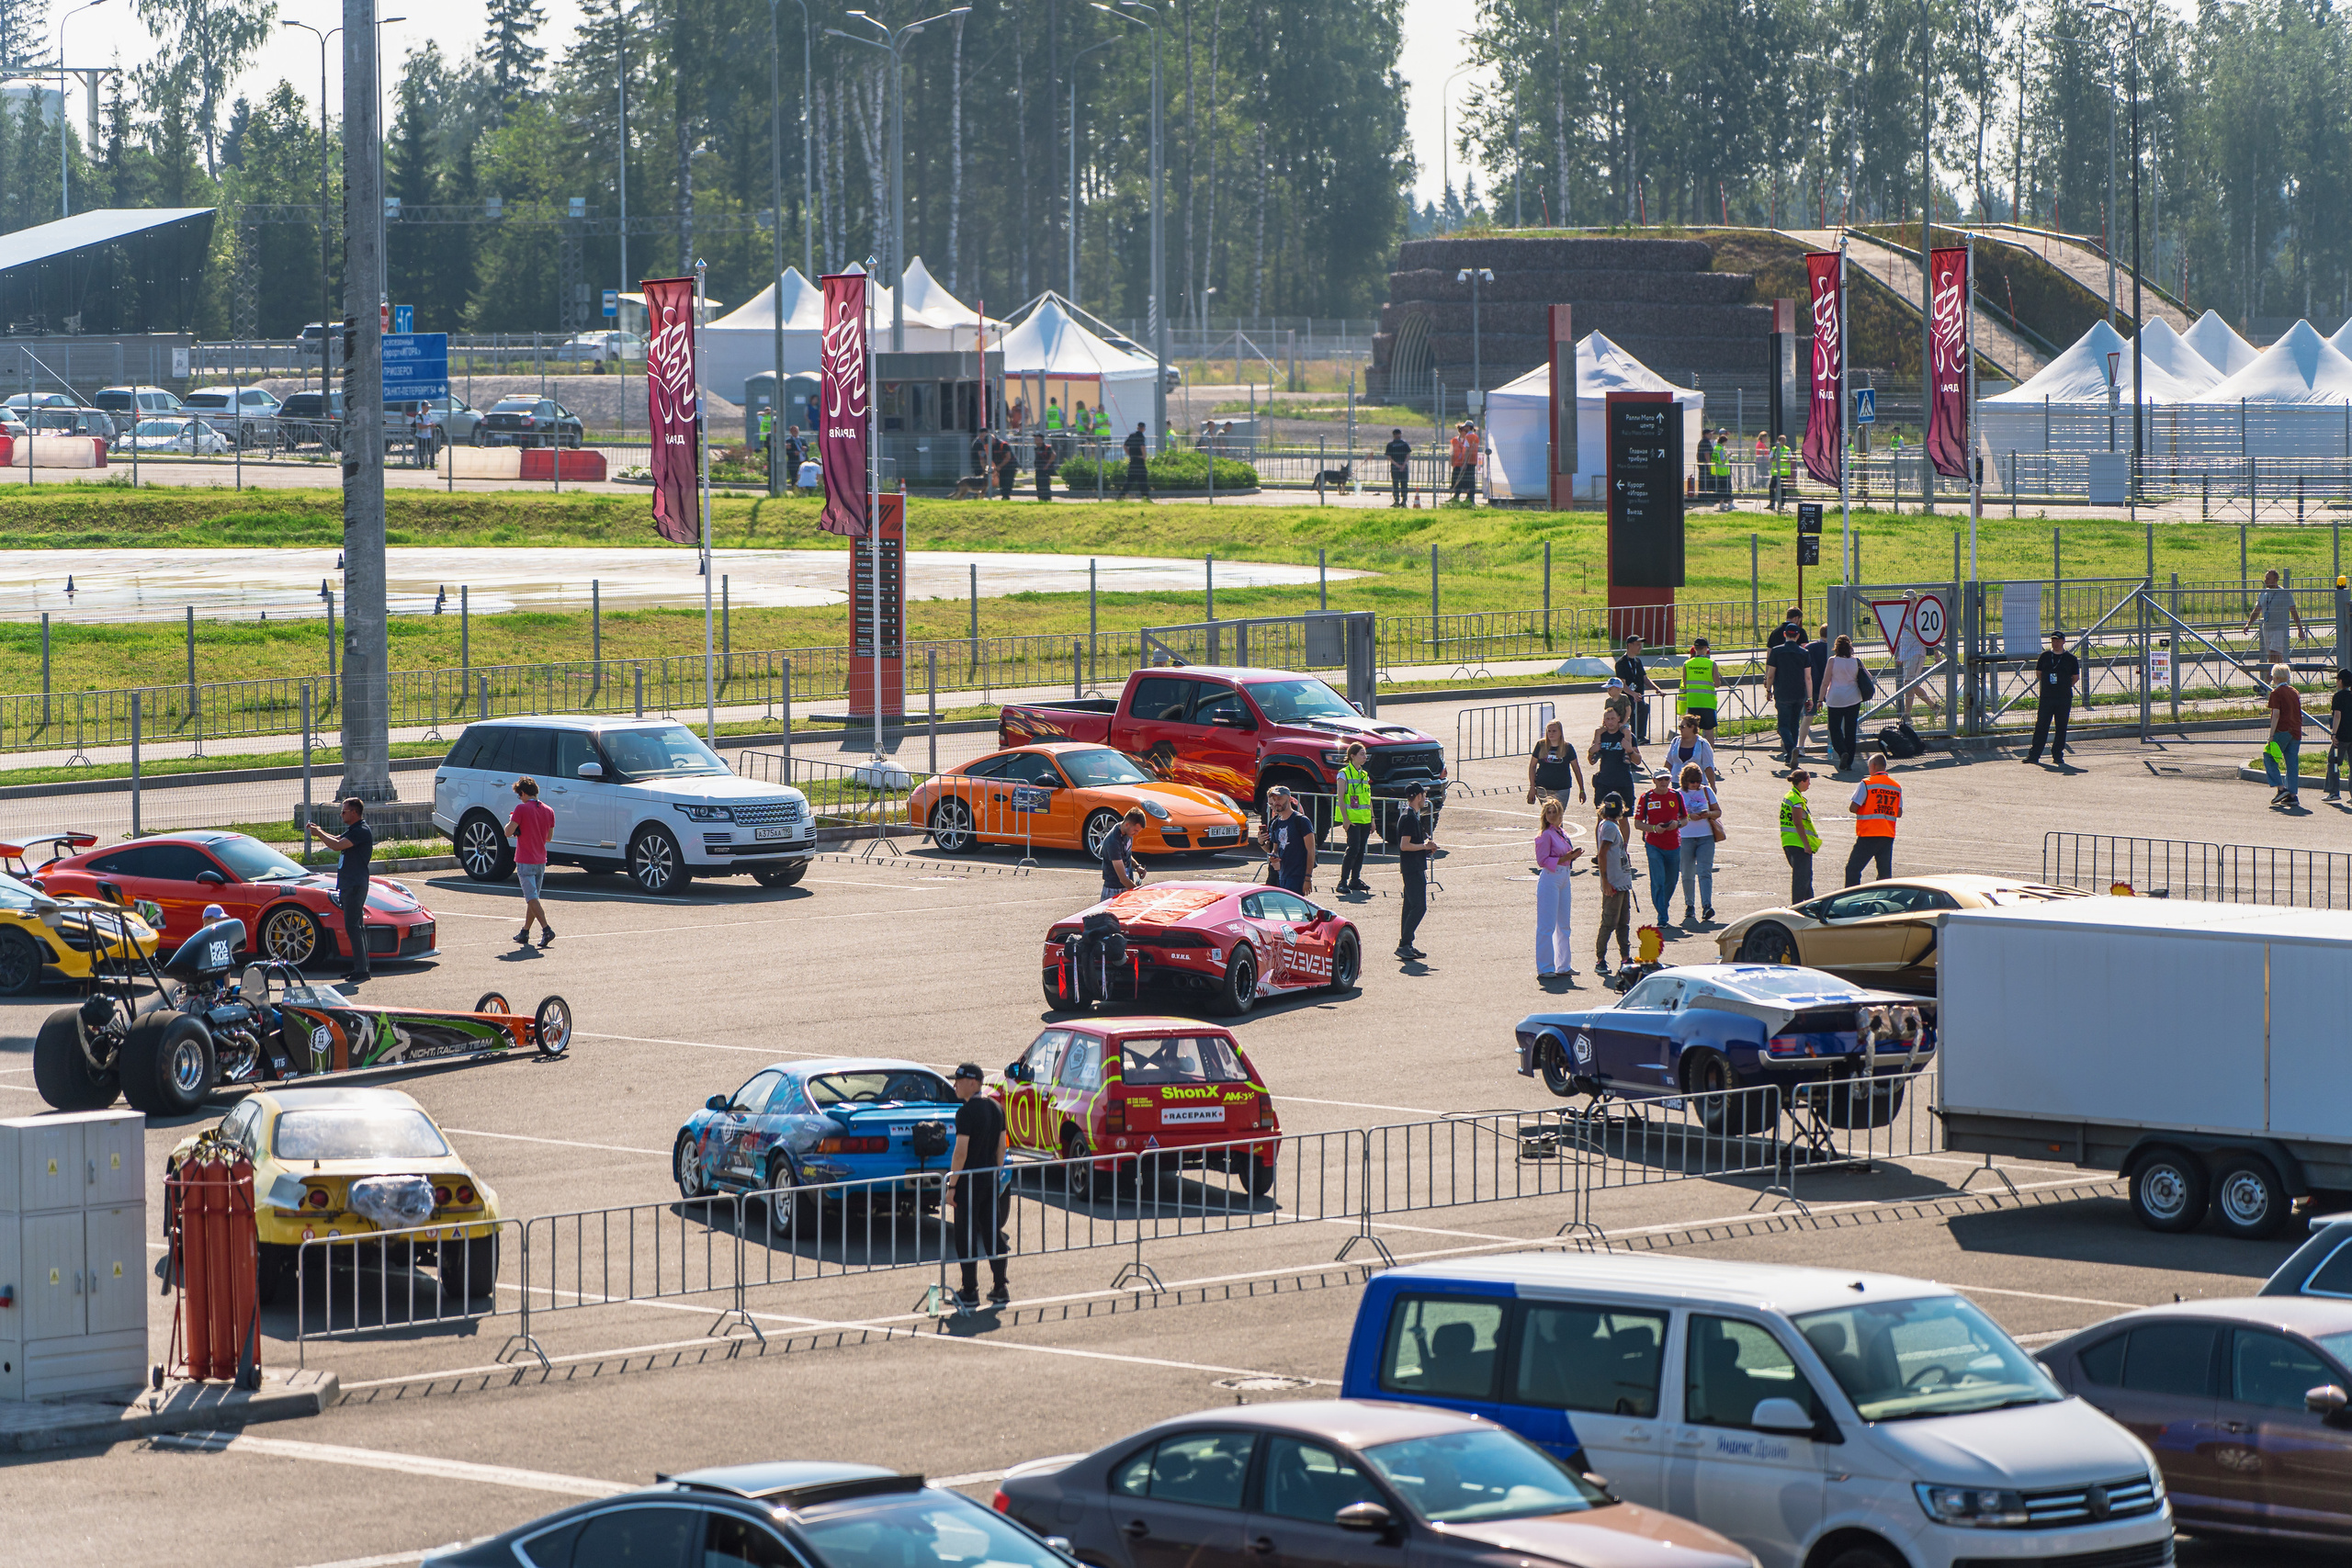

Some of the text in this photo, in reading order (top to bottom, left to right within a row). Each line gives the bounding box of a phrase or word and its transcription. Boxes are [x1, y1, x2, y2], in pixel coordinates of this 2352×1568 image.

[1921, 611, 1939, 631] 20
[1391, 753, 1430, 764] RAM
[1876, 794, 1896, 806] 217
[1211, 828, 1221, 836] RENT
[1226, 827, 1238, 835] DRIVE
[209, 940, 228, 953] MAX
[469, 1037, 494, 1052] TEAM
[1161, 1085, 1219, 1100] ShonX
[1169, 1111, 1218, 1120] RACEPARK
